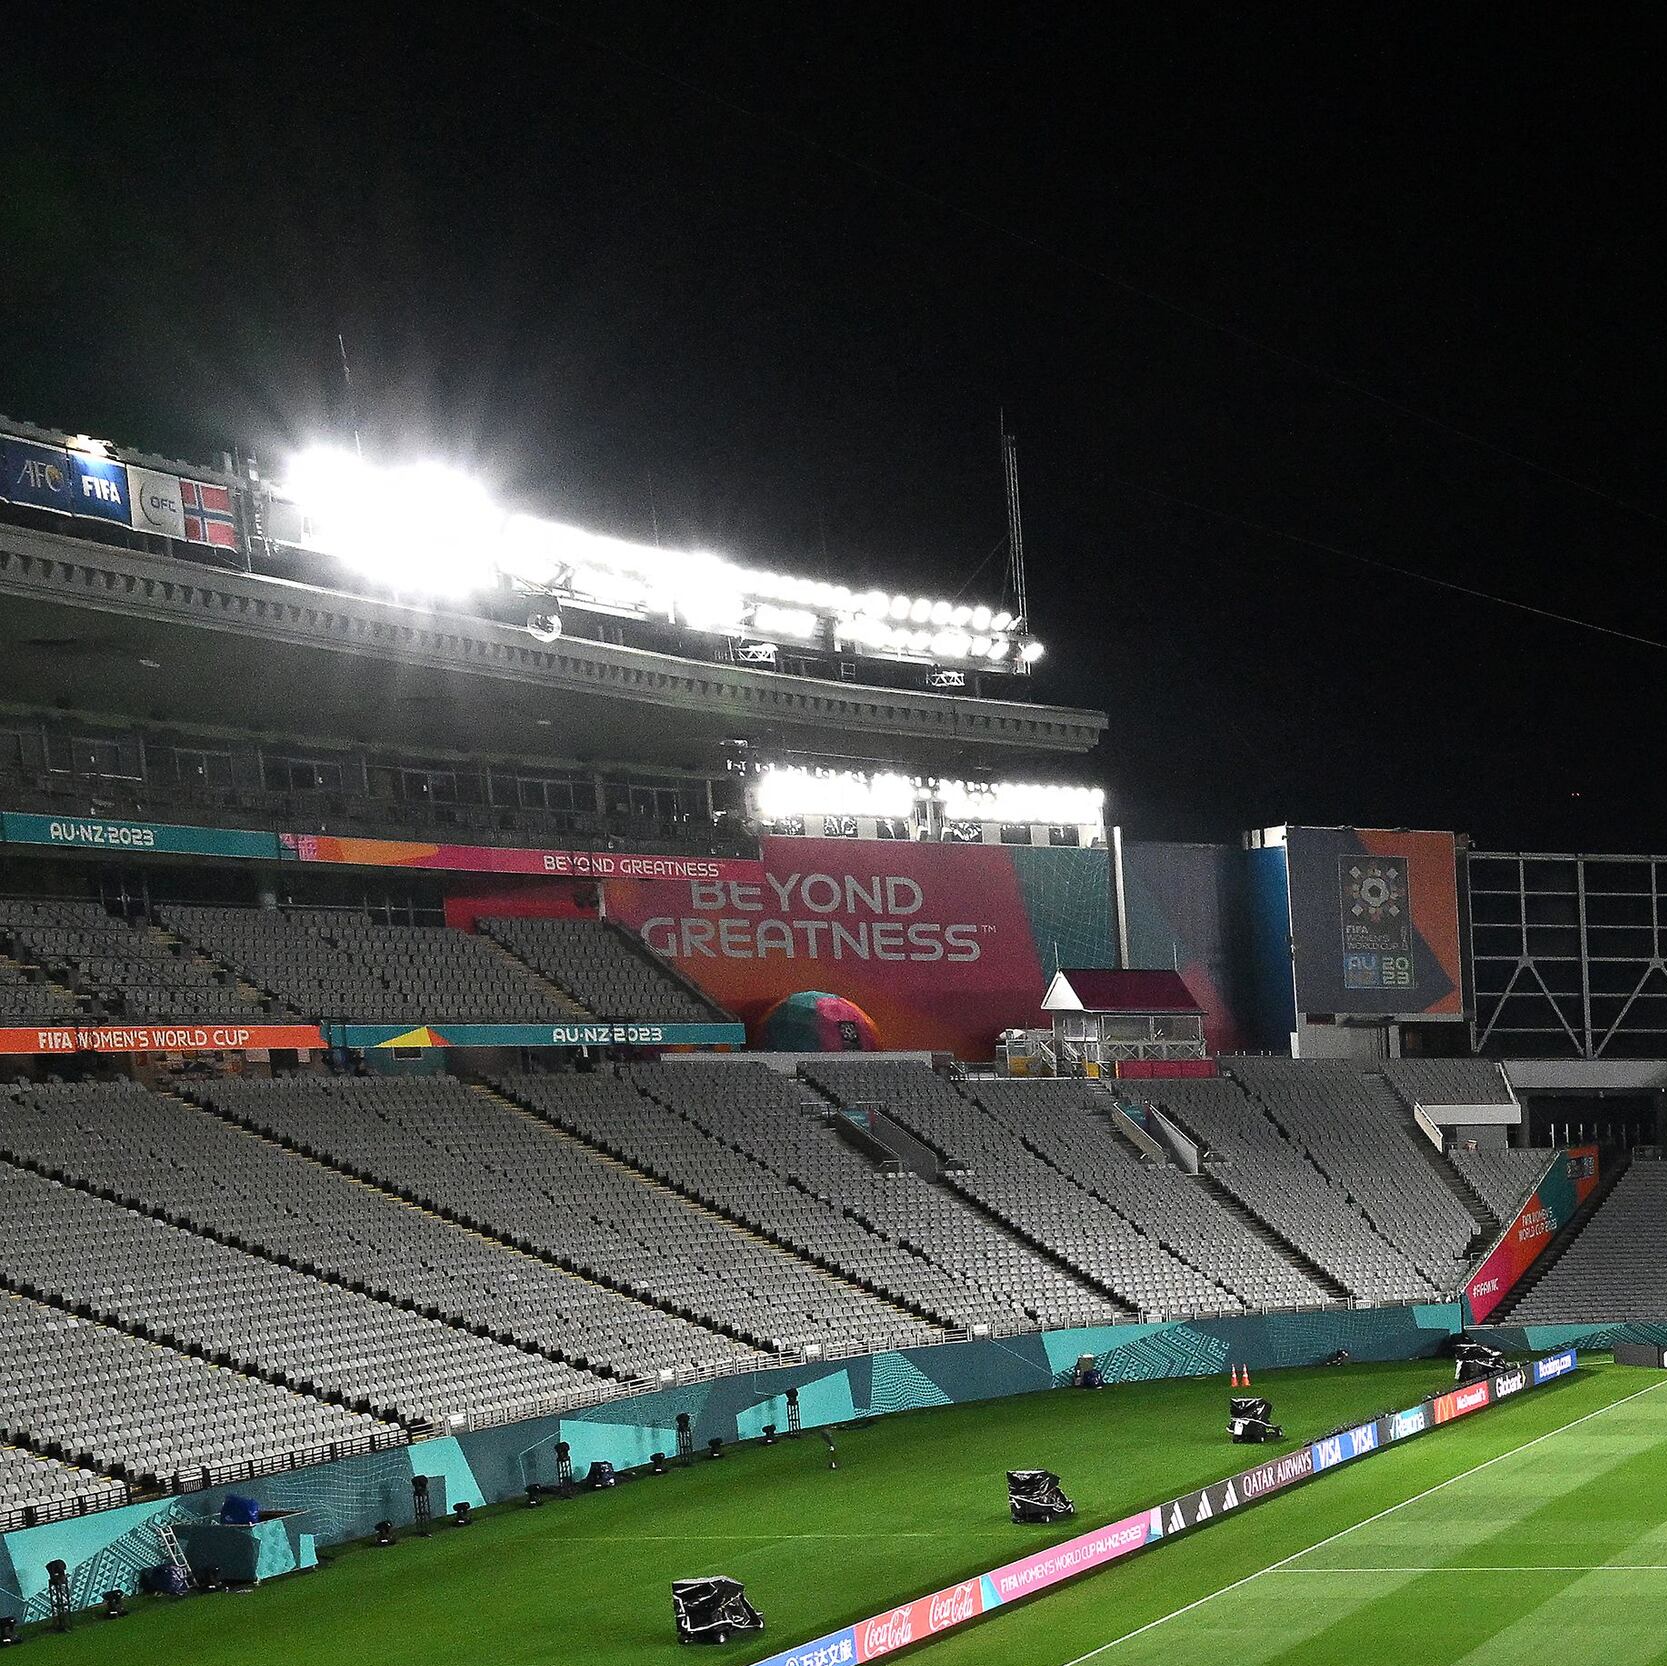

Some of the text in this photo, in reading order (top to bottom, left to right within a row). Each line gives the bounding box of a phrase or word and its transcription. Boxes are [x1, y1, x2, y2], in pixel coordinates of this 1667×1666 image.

[81, 475, 121, 504] FIFA
[543, 855, 615, 874] BEYOND
[691, 873, 923, 915] BEYOND
[38, 1030, 250, 1049] FIFA WOMEN'S WORLD CUP
[1316, 1438, 1342, 1469] VISA
[1350, 1425, 1375, 1455] VISA
[1243, 1450, 1313, 1497] QATAR AIRWAYS
